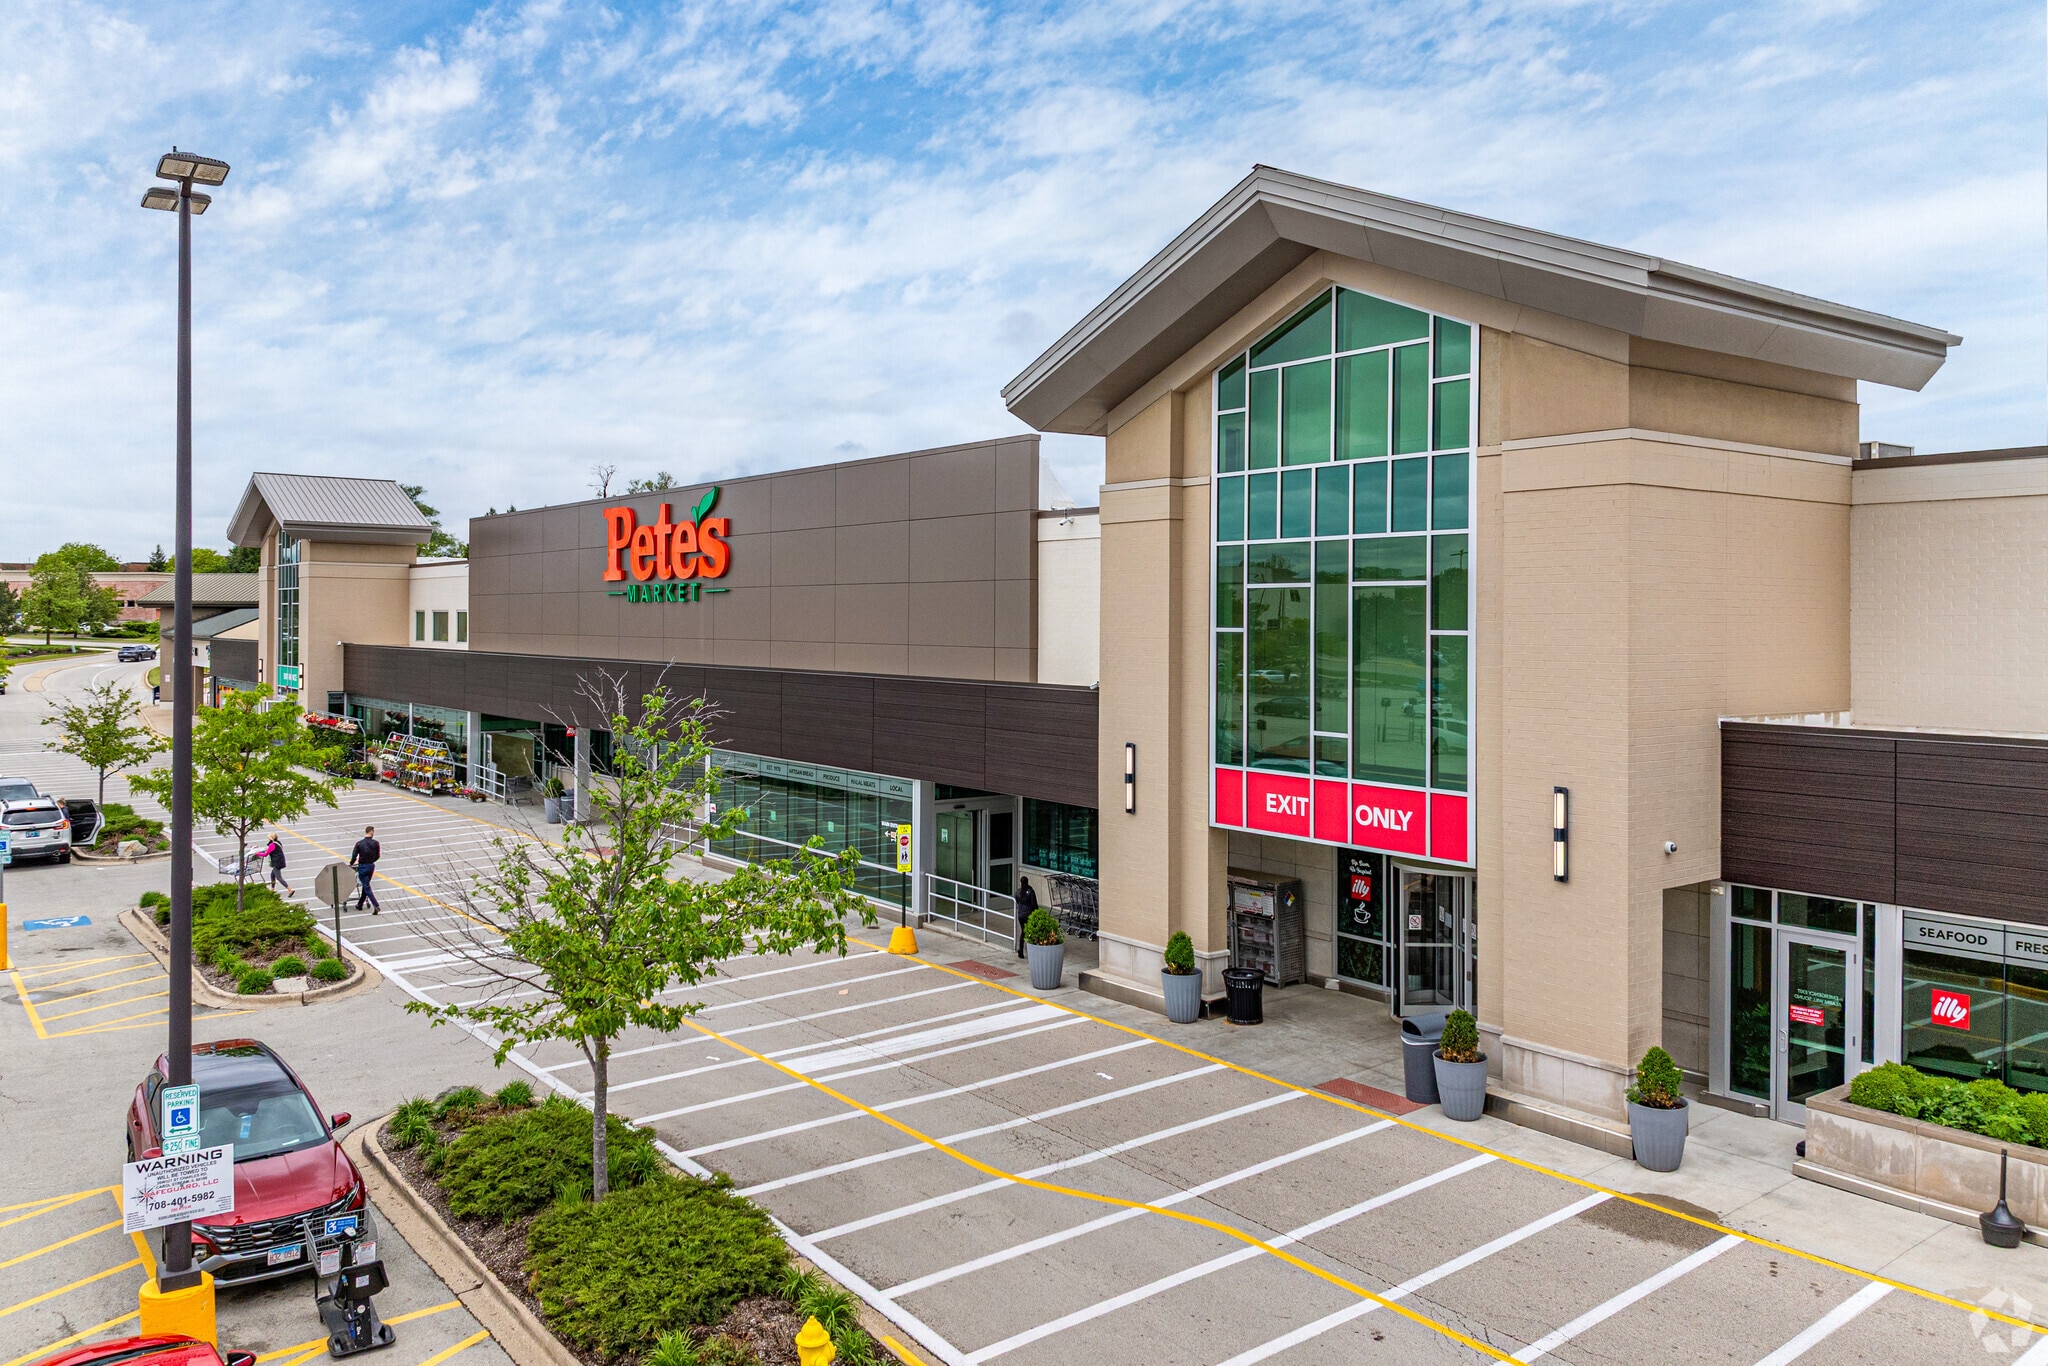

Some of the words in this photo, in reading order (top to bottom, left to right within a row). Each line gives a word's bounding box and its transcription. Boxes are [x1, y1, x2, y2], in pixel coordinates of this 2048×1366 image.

[602, 486, 730, 581] Pete's
[626, 582, 701, 603] MARKET
[822, 773, 840, 782] PRODUCE
[850, 778, 862, 786] HALAL
[863, 780, 876, 788] MEATS
[889, 784, 903, 793] LOCAL
[1265, 793, 1310, 817] EXIT
[1355, 804, 1413, 832] ONLY
[1352, 879, 1370, 898] illy
[1919, 926, 1988, 946] SEAFOOD
[1933, 996, 1968, 1023] illy
[165, 1089, 197, 1100] RESERVED
[167, 1098, 195, 1107] PARKING
[185, 1138, 199, 1149] FINE
[136, 1149, 223, 1174] WARNING
[147, 1165, 190, 1178] UNAUTHORIZED
[190, 1160, 217, 1169] VEHICLES
[180, 1168, 199, 1176] TOWED
[203, 1178, 219, 1187] LLC
[149, 1190, 215, 1211] 708-401-5982
